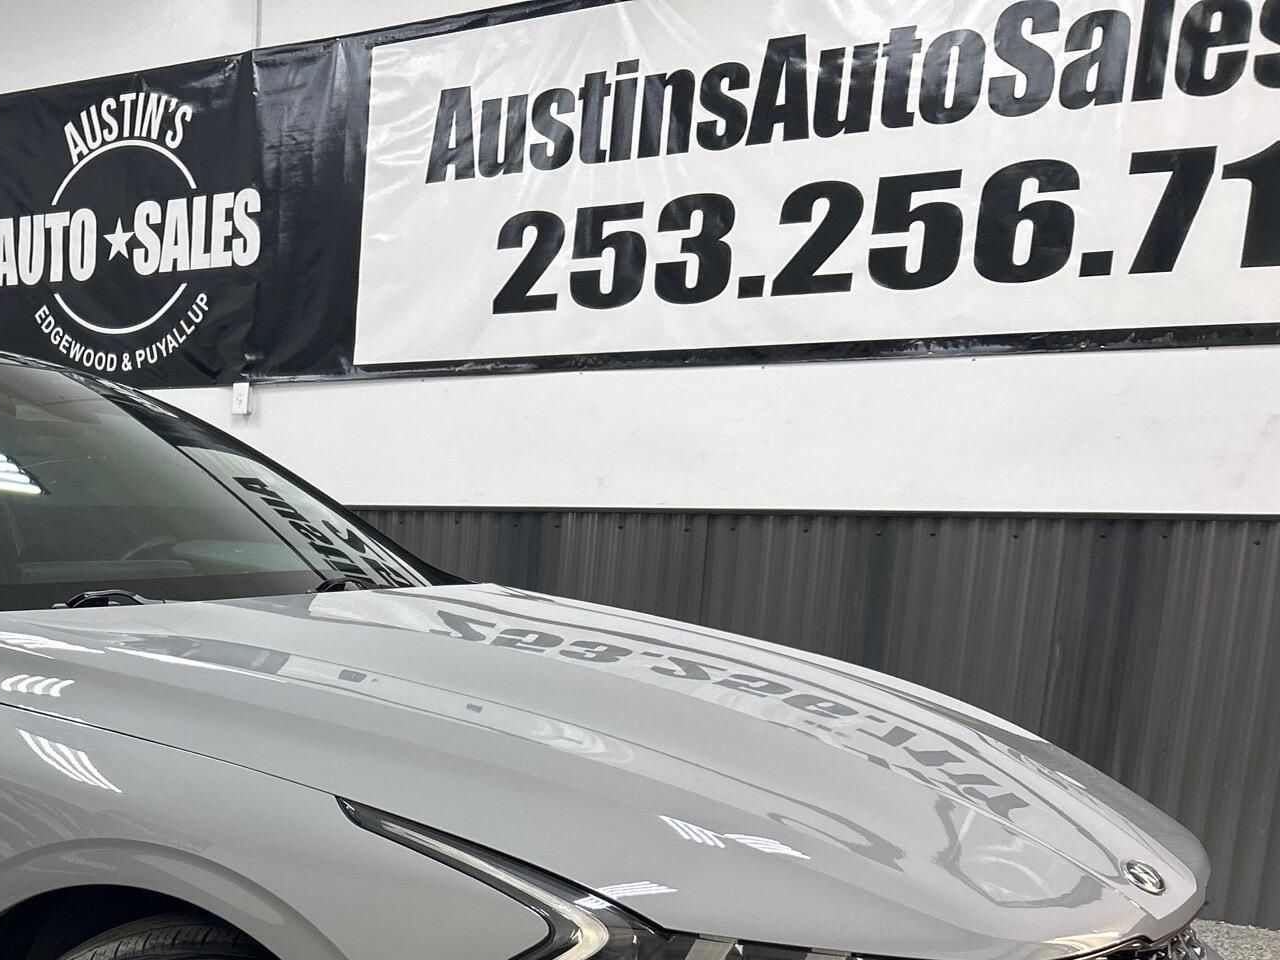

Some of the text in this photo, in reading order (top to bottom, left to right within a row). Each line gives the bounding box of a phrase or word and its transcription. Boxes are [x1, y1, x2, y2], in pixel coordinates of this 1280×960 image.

[64, 92, 193, 165] AUSTIN'S
[133, 188, 261, 276] SALES
[492, 139, 1280, 315] 253.256.71
[34, 293, 209, 372] EDGEWOOD & PUYALLUP
